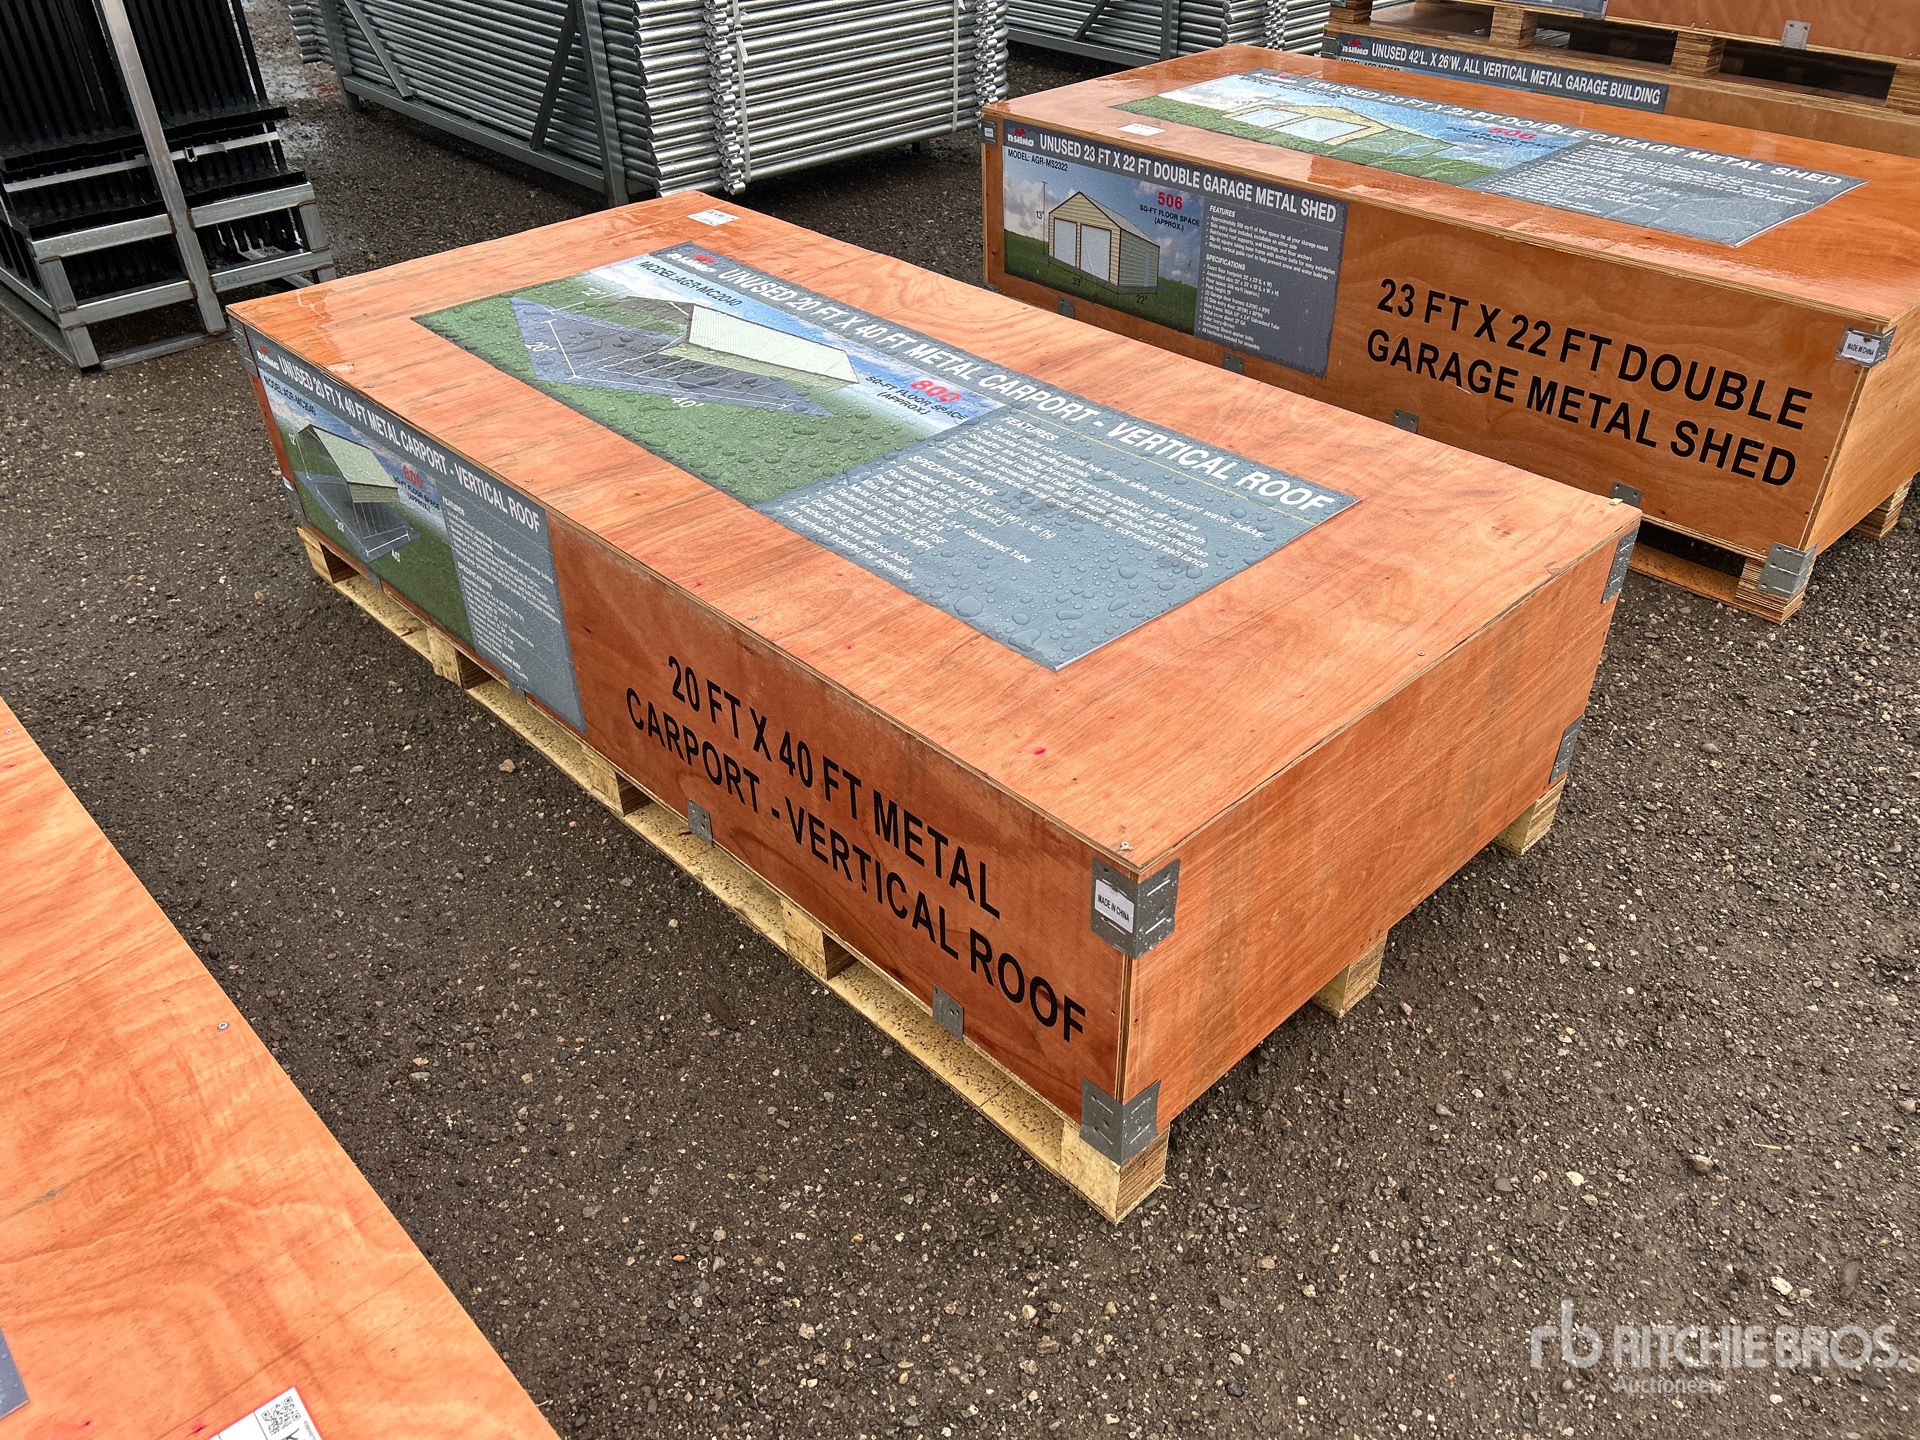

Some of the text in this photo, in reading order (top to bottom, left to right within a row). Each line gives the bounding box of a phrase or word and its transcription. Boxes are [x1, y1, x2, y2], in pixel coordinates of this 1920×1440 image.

[1372, 43, 1406, 62] UNUSED
[1430, 52, 1437, 66] X
[1463, 58, 1480, 74] ALL
[1483, 61, 1527, 82] VERTICAL
[1530, 69, 1562, 88] METAL
[1566, 75, 1609, 96] GARAGE
[1609, 81, 1660, 104] BUILDING
[1498, 116, 1589, 137] DOUBLE
[1588, 133, 1684, 154] GARAGE
[1683, 151, 1762, 171] METAL
[1770, 167, 1841, 184] SHED
[1040, 133, 1336, 222] UNUSED 23 FT X 22 FT DOUBLE GARAGE METAL SHED
[1157, 191, 1182, 209] 506
[1158, 209, 1178, 220] FLOOR
[1179, 215, 1199, 226] SPACE
[1209, 205, 1235, 217] FEATURES
[1205, 253, 1245, 270] SPECIFICATIONS
[1377, 278, 1813, 430] 23 FT X 22 FT DOUBLE
[718, 268, 798, 301] UNUSED
[786, 297, 816, 311] 20
[810, 302, 850, 320] FT
[833, 316, 865, 329] X
[854, 324, 887, 338] 40
[875, 332, 917, 348] FT
[903, 344, 983, 379] METAL
[978, 374, 1099, 421] CARPORT
[1107, 422, 1237, 479] VERTICAL
[1235, 471, 1334, 510] ROOF
[911, 380, 960, 402] 800
[1367, 329, 1795, 486] GARAGE METAL SHED
[1000, 416, 1059, 440] FEATURES
[324, 383, 336, 405] FT
[335, 389, 345, 411] X
[355, 401, 368, 425] FT
[367, 410, 400, 446] METAL
[400, 430, 447, 476] CARPORT
[454, 462, 508, 514] VERTICAL
[508, 496, 540, 532] ROOF
[908, 455, 997, 495] SPECIFICATIONS
[1040, 446, 1062, 455] roof
[1104, 470, 1129, 483] snow
[1148, 490, 1169, 499] and
[1165, 496, 1203, 512] prevent
[1203, 510, 1232, 523] water
[1230, 521, 1265, 537] buildup
[861, 550, 877, 559] for
[874, 558, 915, 579] assembly
[1100, 519, 1116, 528] for
[1115, 526, 1159, 546] corrosion
[1157, 544, 1208, 568] resistance
[1156, 533, 1208, 557] connection
[669, 656, 1000, 919] 20 FT X 40 FT METAL
[626, 688, 760, 814] CARPORT
[785, 796, 958, 960] VERTICAL
[970, 927, 1086, 1042] ROOF
[1098, 894, 1110, 909] MADE
[1111, 903, 1115, 912] IN
